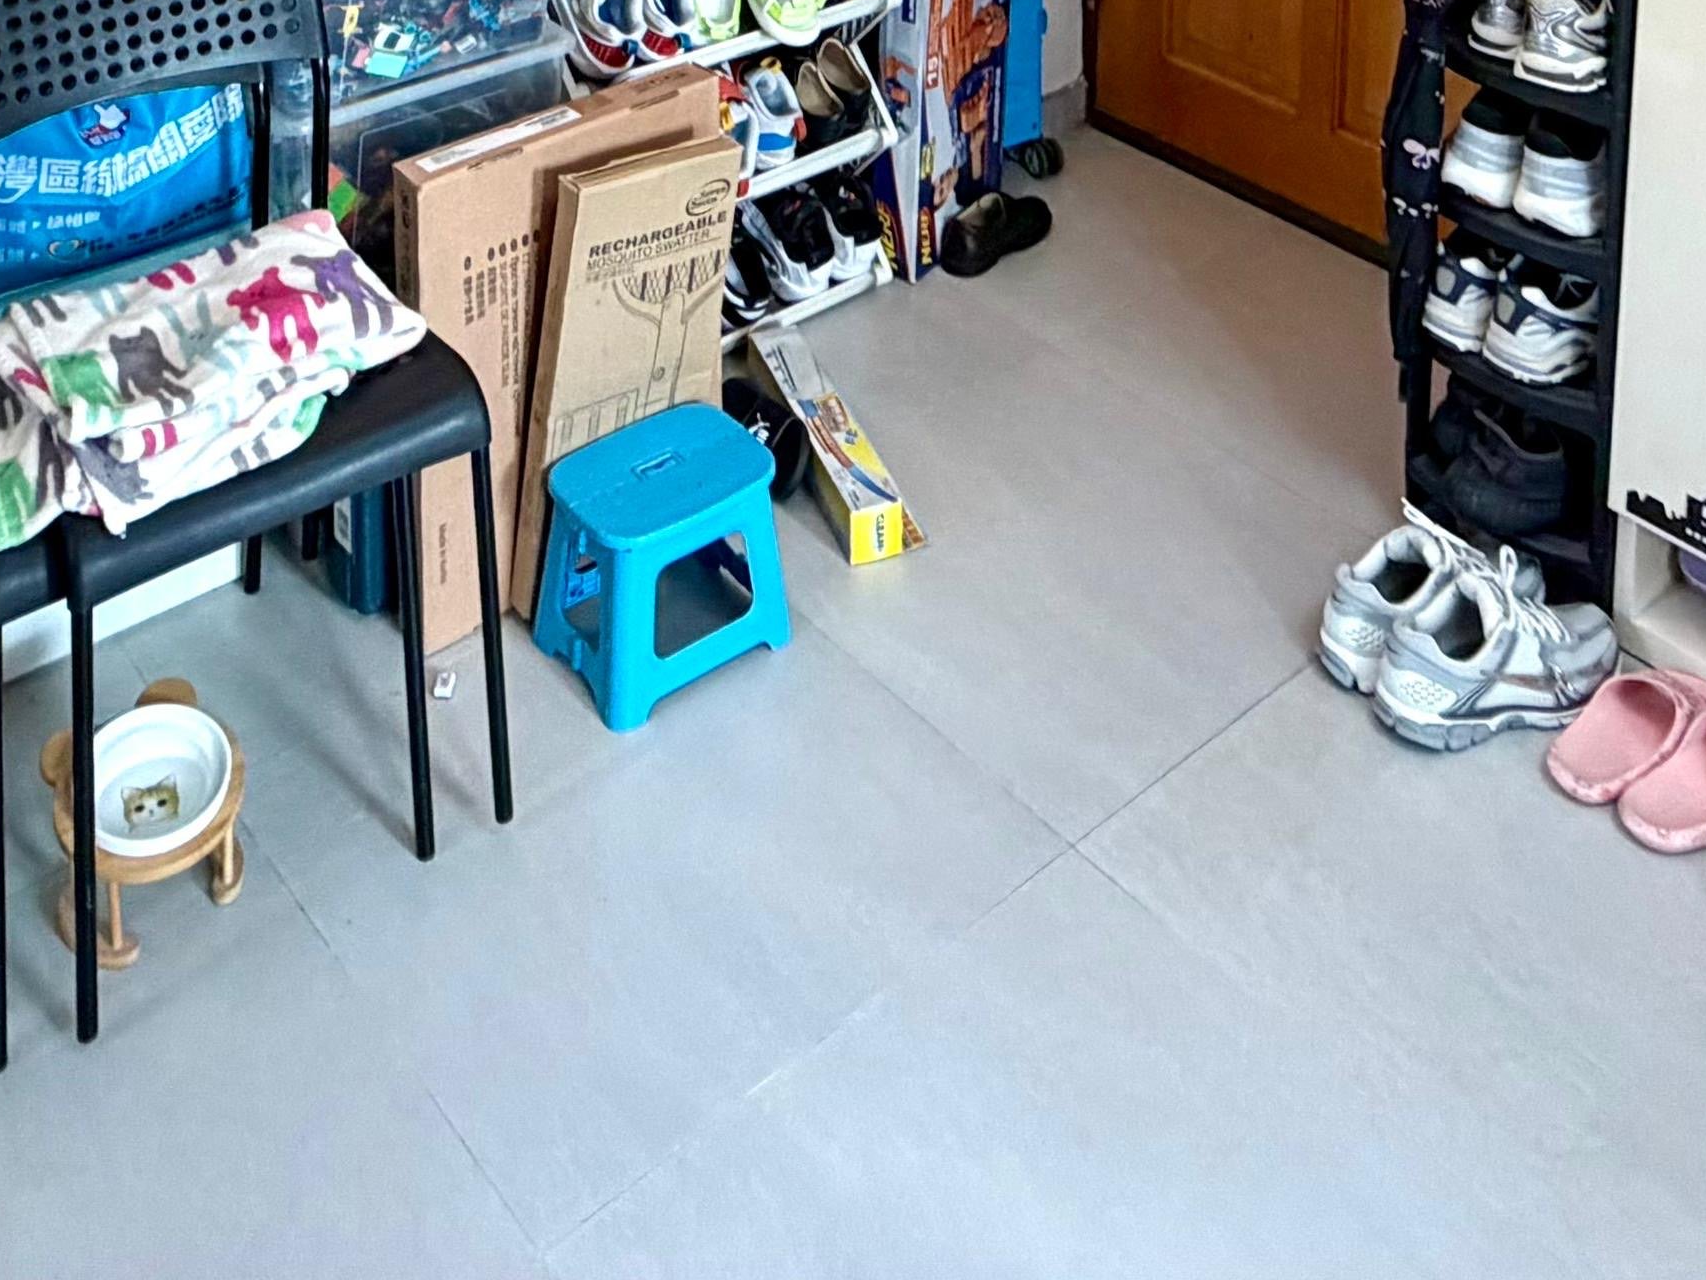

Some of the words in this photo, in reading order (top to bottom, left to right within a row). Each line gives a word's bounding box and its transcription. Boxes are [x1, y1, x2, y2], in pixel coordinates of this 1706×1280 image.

[586, 243, 653, 271] MOSQUITO
[654, 228, 712, 255] SWATTER
[589, 208, 727, 260] RECHARGEABLE
